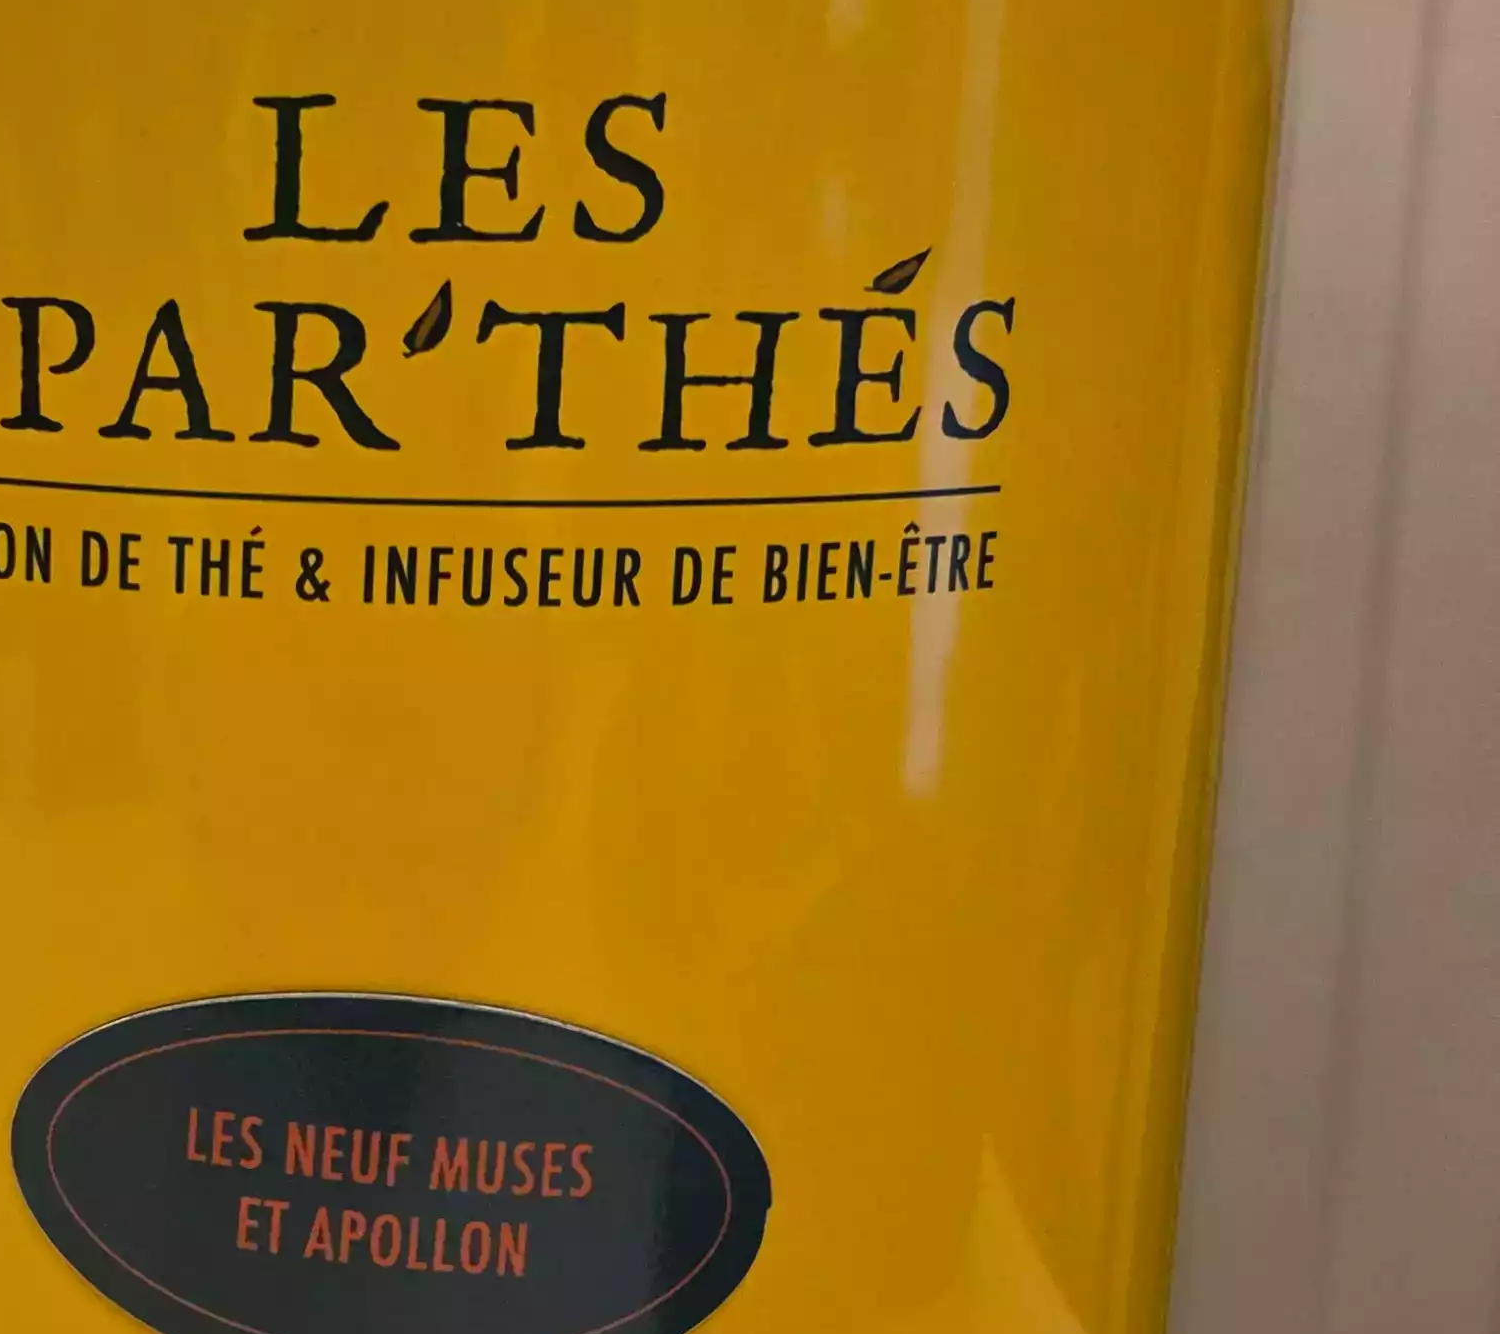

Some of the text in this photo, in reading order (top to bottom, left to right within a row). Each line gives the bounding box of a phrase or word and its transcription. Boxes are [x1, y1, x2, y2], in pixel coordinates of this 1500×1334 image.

[243, 92, 667, 242] LES
[80, 531, 141, 591] DE
[169, 526, 265, 599] THÉ
[296, 548, 331, 602] &
[364, 544, 642, 608] INFUSEUR
[671, 547, 736, 606] DE
[762, 524, 996, 602] BIEN-ÊTRE
[186, 1107, 594, 1198] LES NEUF MUSES
[236, 1197, 529, 1277] ET APOLLON
